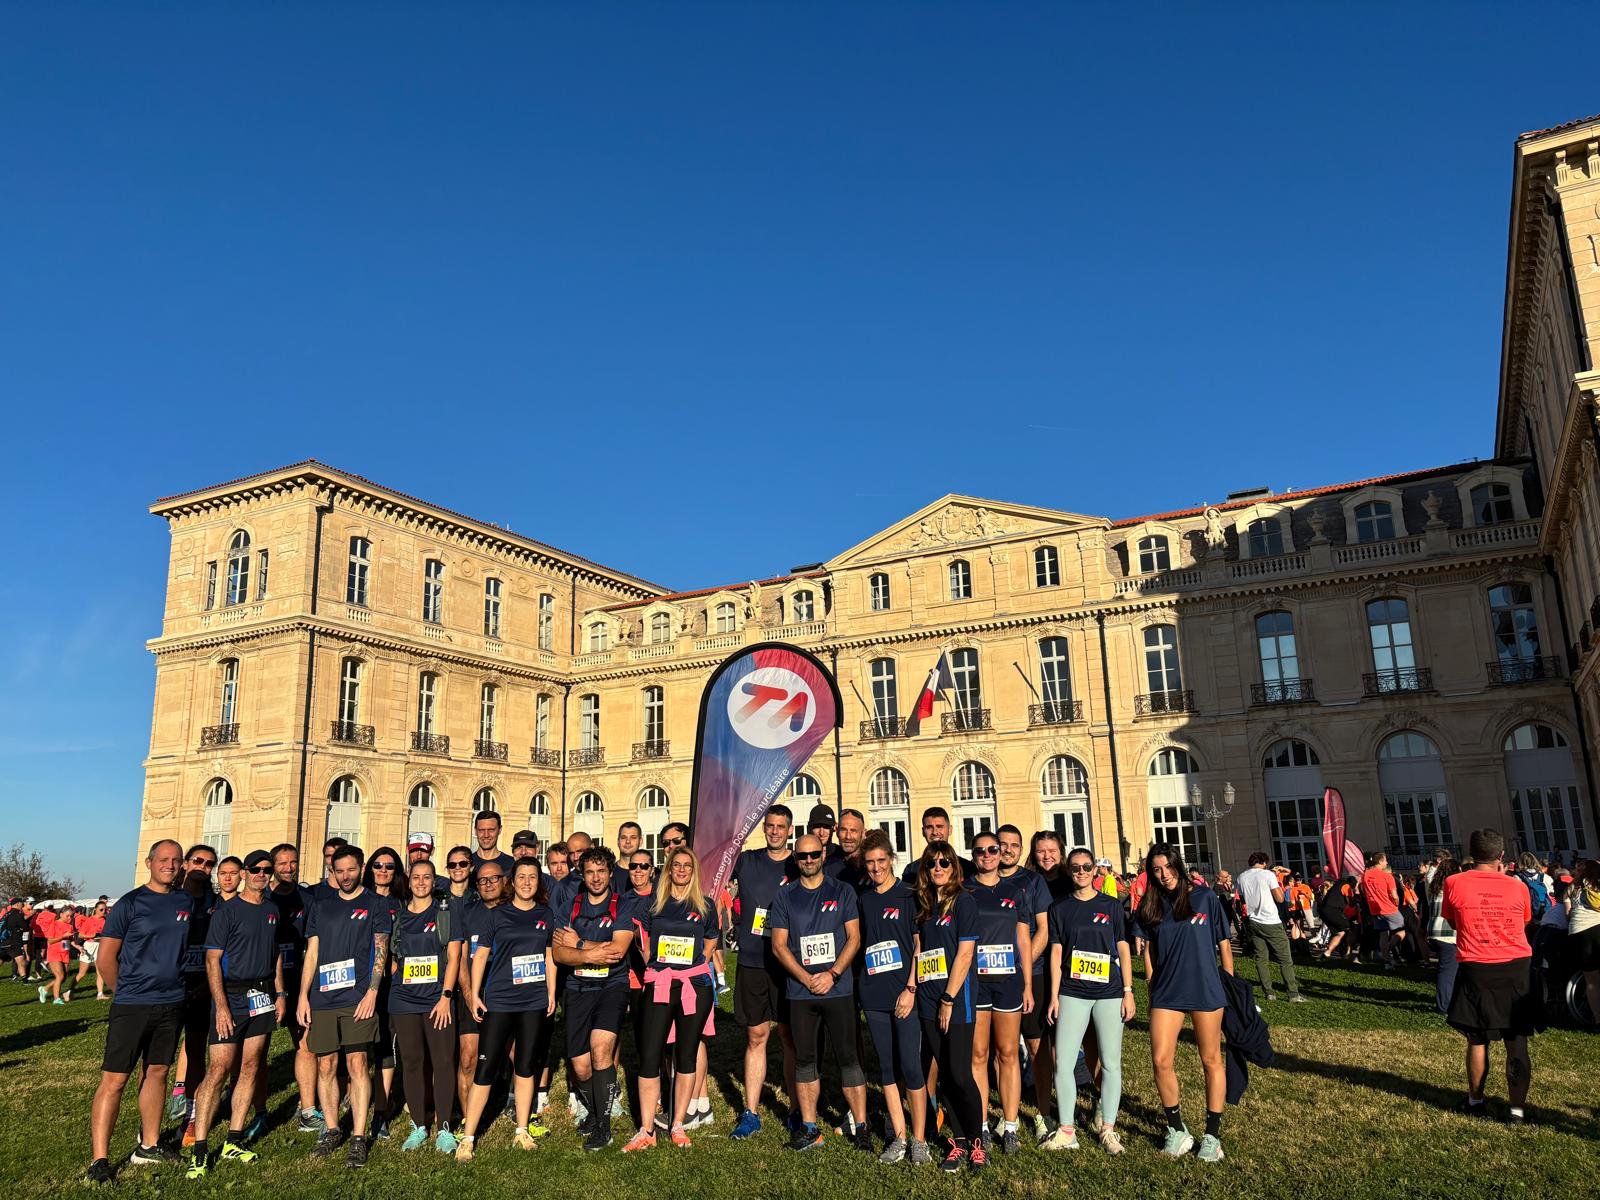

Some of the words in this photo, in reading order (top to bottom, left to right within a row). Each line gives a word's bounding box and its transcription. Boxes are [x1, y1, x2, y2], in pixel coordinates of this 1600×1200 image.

[714, 847, 735, 888] énergie
[733, 822, 752, 848] pour
[747, 811, 759, 823] le
[758, 767, 790, 812] nucléaire
[806, 942, 830, 958] 6967
[871, 949, 894, 967] 1740
[922, 958, 939, 975] 3301
[985, 953, 1007, 967] 1041
[1078, 959, 1103, 975] 3794
[326, 968, 348, 985] 1403
[409, 964, 432, 978] 3308
[519, 963, 541, 977] 1044
[251, 993, 271, 1009] 1036
